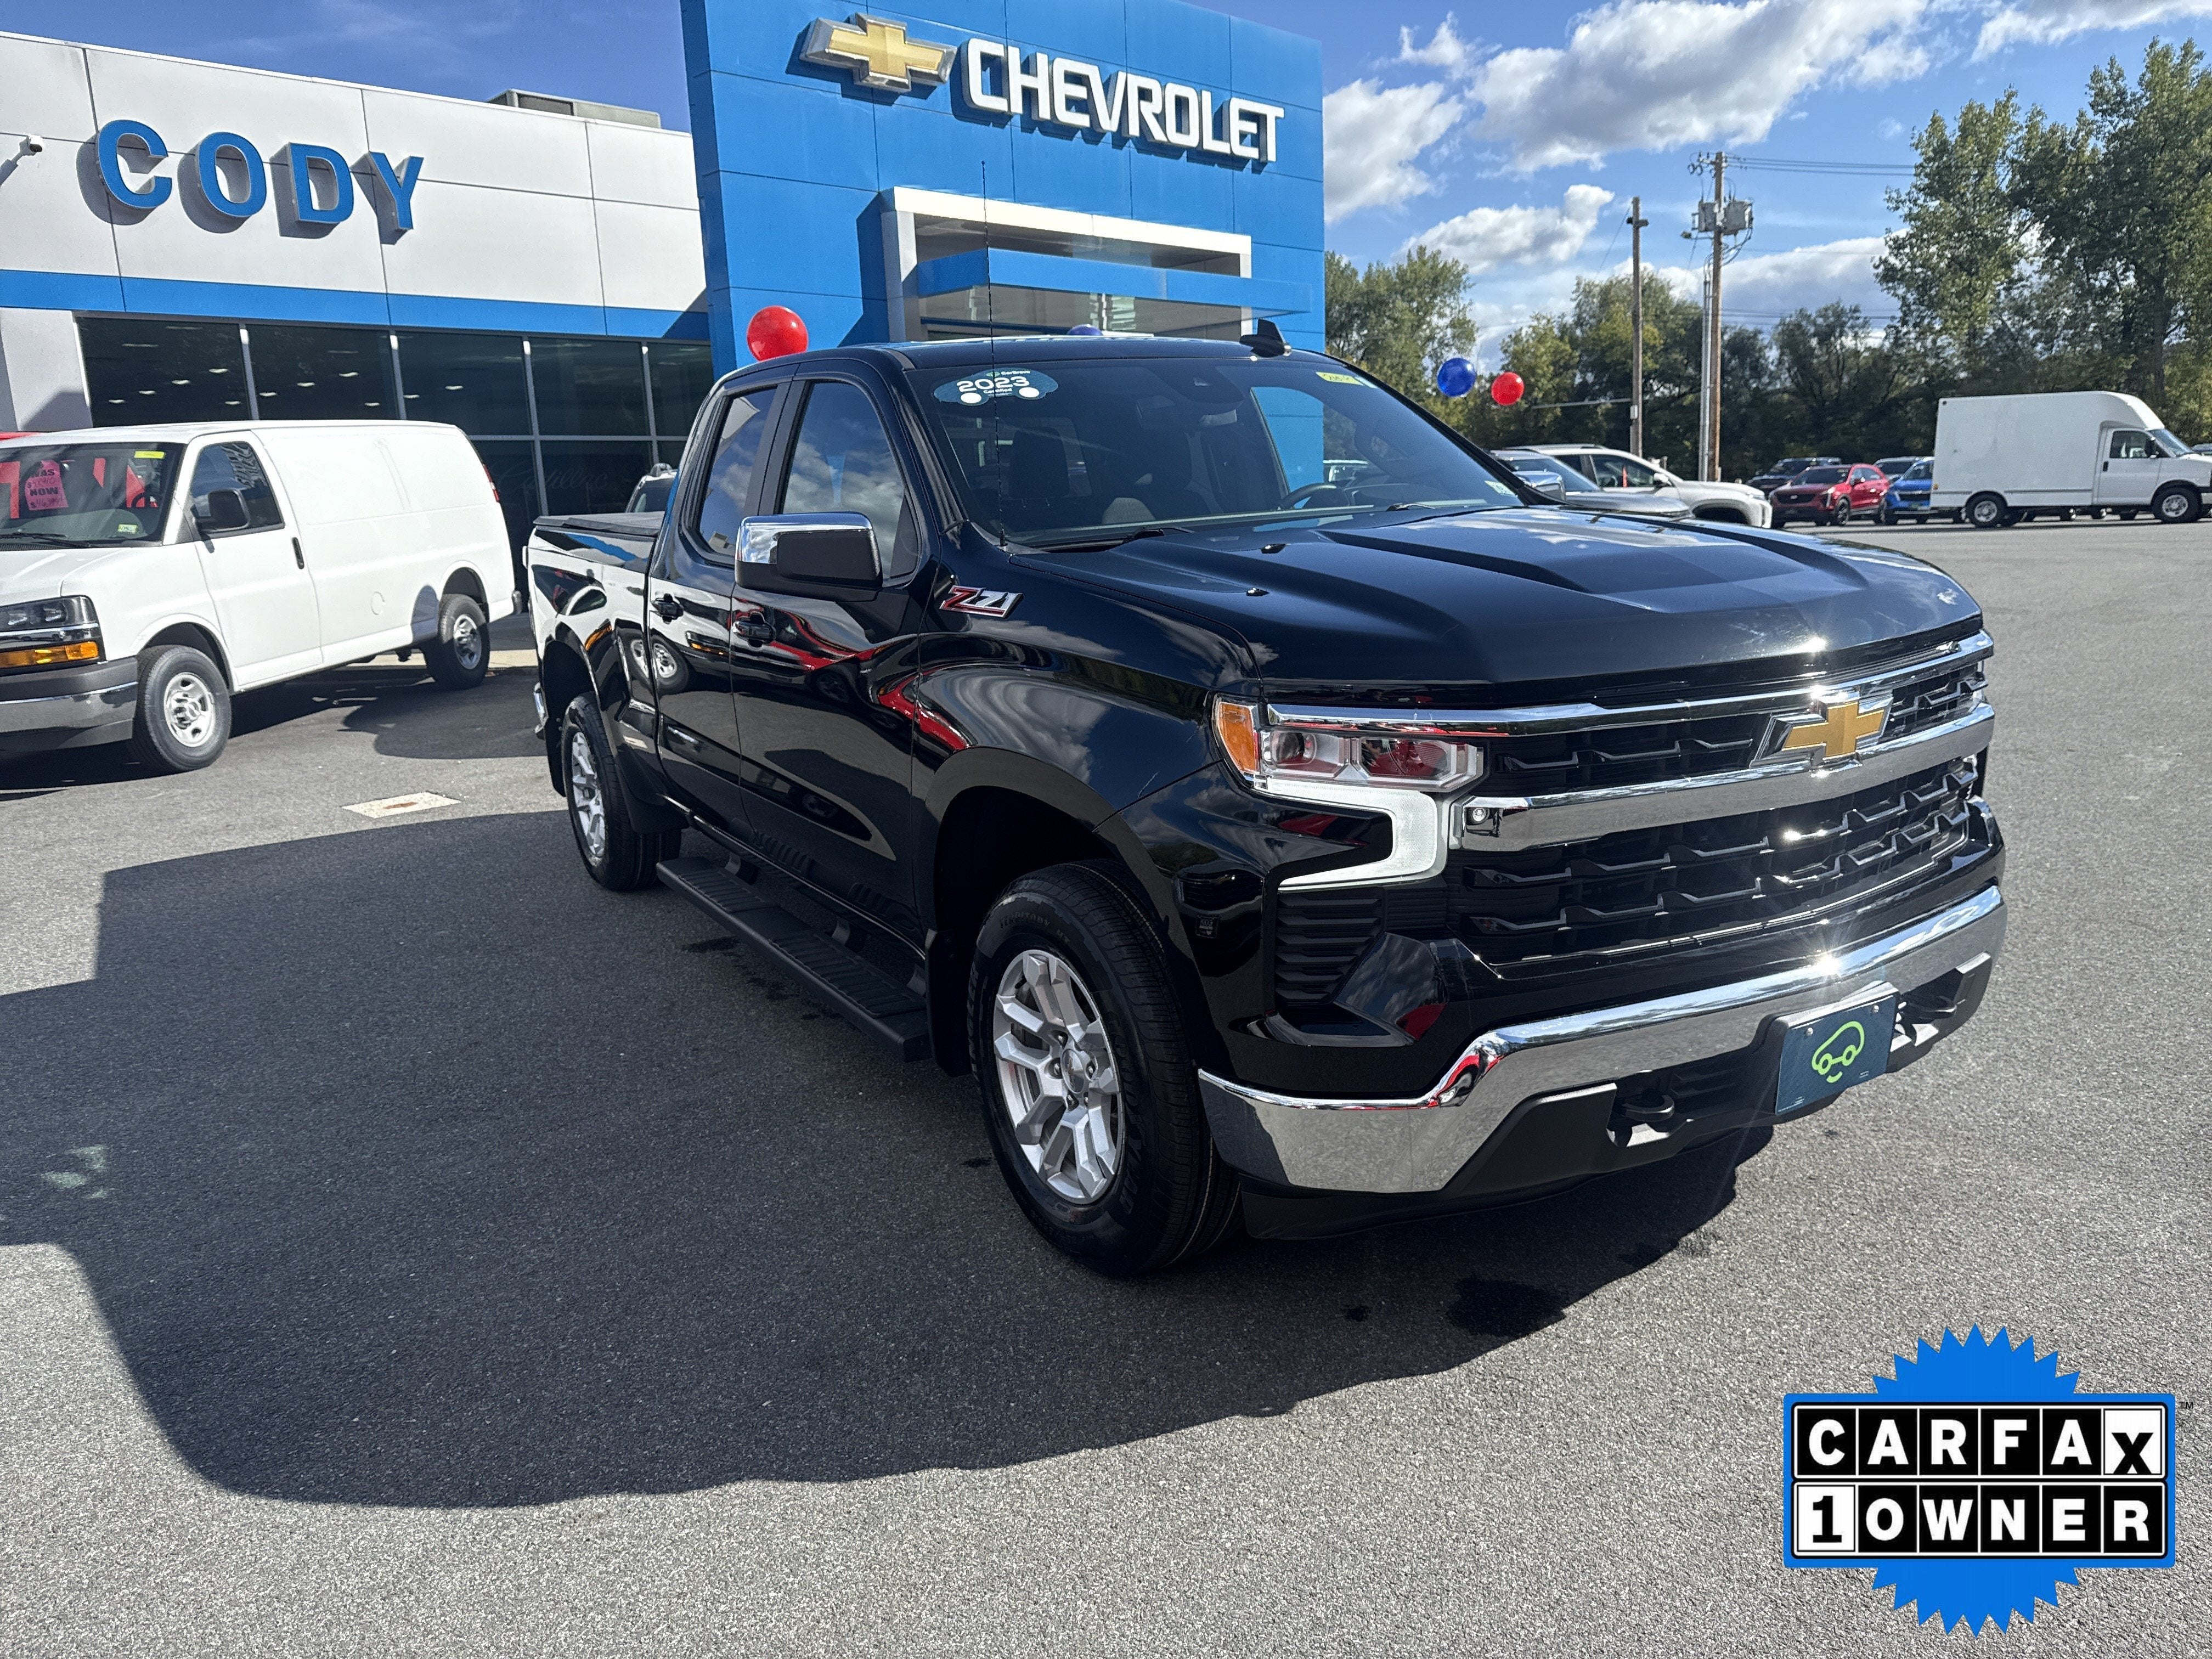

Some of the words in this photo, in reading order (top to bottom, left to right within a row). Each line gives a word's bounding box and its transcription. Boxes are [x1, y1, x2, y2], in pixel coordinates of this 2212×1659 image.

[962, 38, 1284, 162] CHEVROLET
[97, 120, 424, 231] CODY
[956, 376, 1030, 392] 2023
[30, 487, 58, 496] NOW
[939, 585, 1024, 618] Z71
